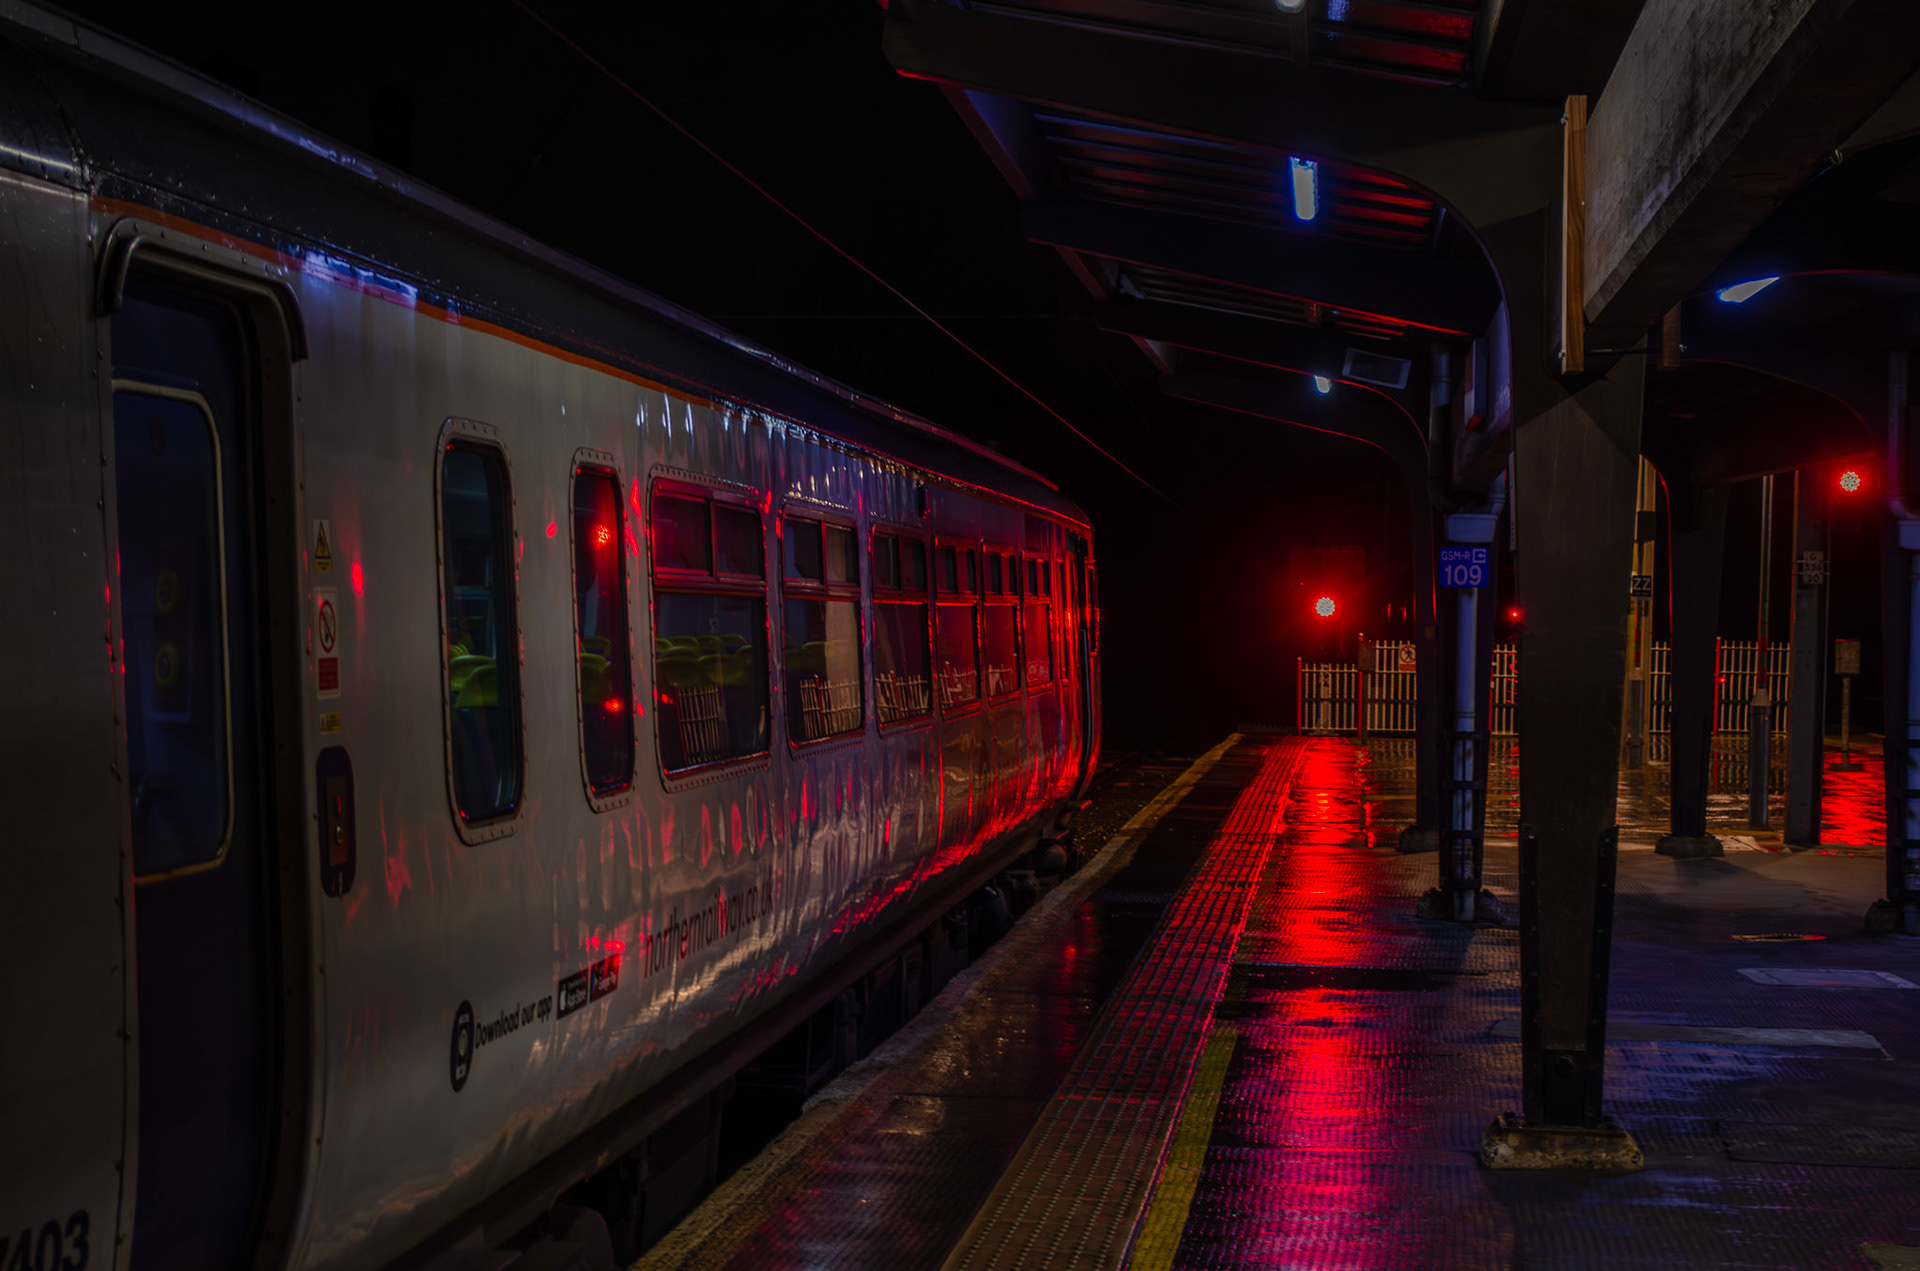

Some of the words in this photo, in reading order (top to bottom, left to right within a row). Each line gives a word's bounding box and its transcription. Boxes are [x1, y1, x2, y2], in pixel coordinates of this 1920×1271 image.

[1441, 550, 1471, 561] GSM-R
[1444, 564, 1482, 586] 109
[645, 881, 774, 979] northernrailway.co.uk
[475, 1003, 520, 1049] Download
[521, 1003, 536, 1026] our
[537, 995, 552, 1023] app
